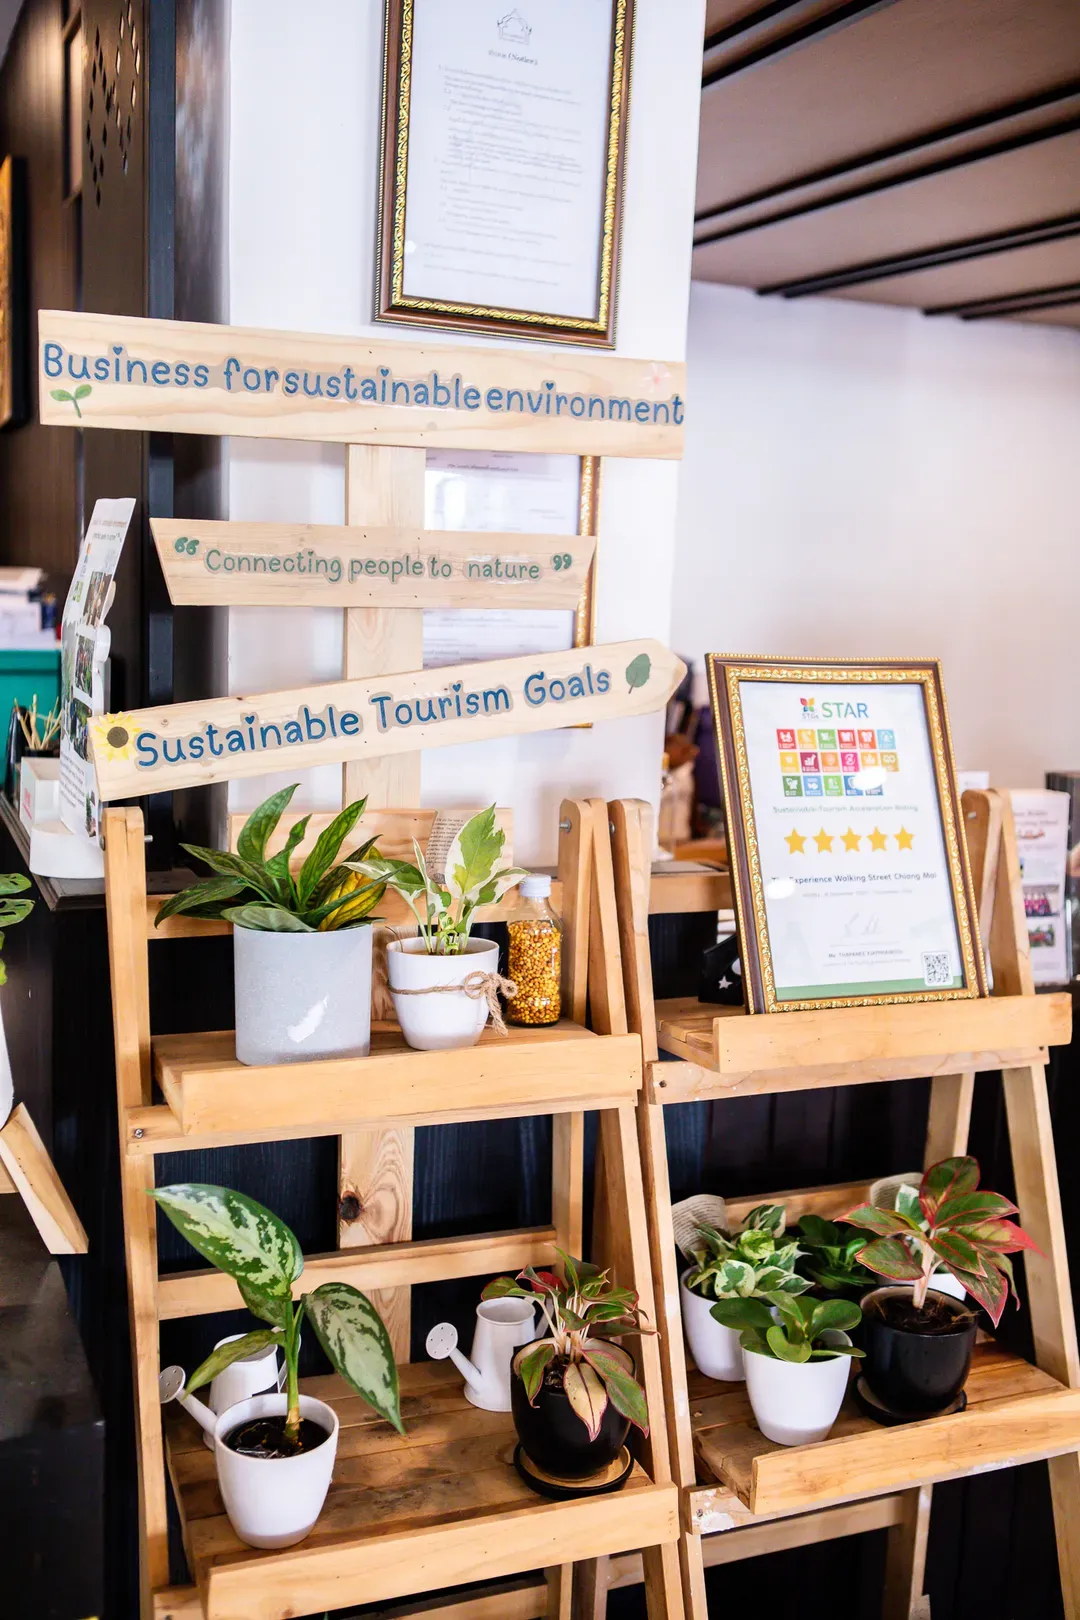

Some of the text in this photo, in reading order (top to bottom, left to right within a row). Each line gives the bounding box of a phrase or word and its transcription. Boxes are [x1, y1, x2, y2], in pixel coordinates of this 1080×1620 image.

[43, 342, 684, 425] Business for sustainable environment
[206, 549, 342, 582] Connecting
[350, 555, 423, 583] people
[430, 557, 452, 577] to
[468, 558, 540, 579] nature
[136, 665, 610, 767] Sustainable Tourism Goals
[821, 702, 869, 718] STAR
[834, 875, 866, 884] Walking
[868, 873, 892, 882] Street
[894, 872, 921, 882] Chiang
[922, 871, 937, 880] Mai
